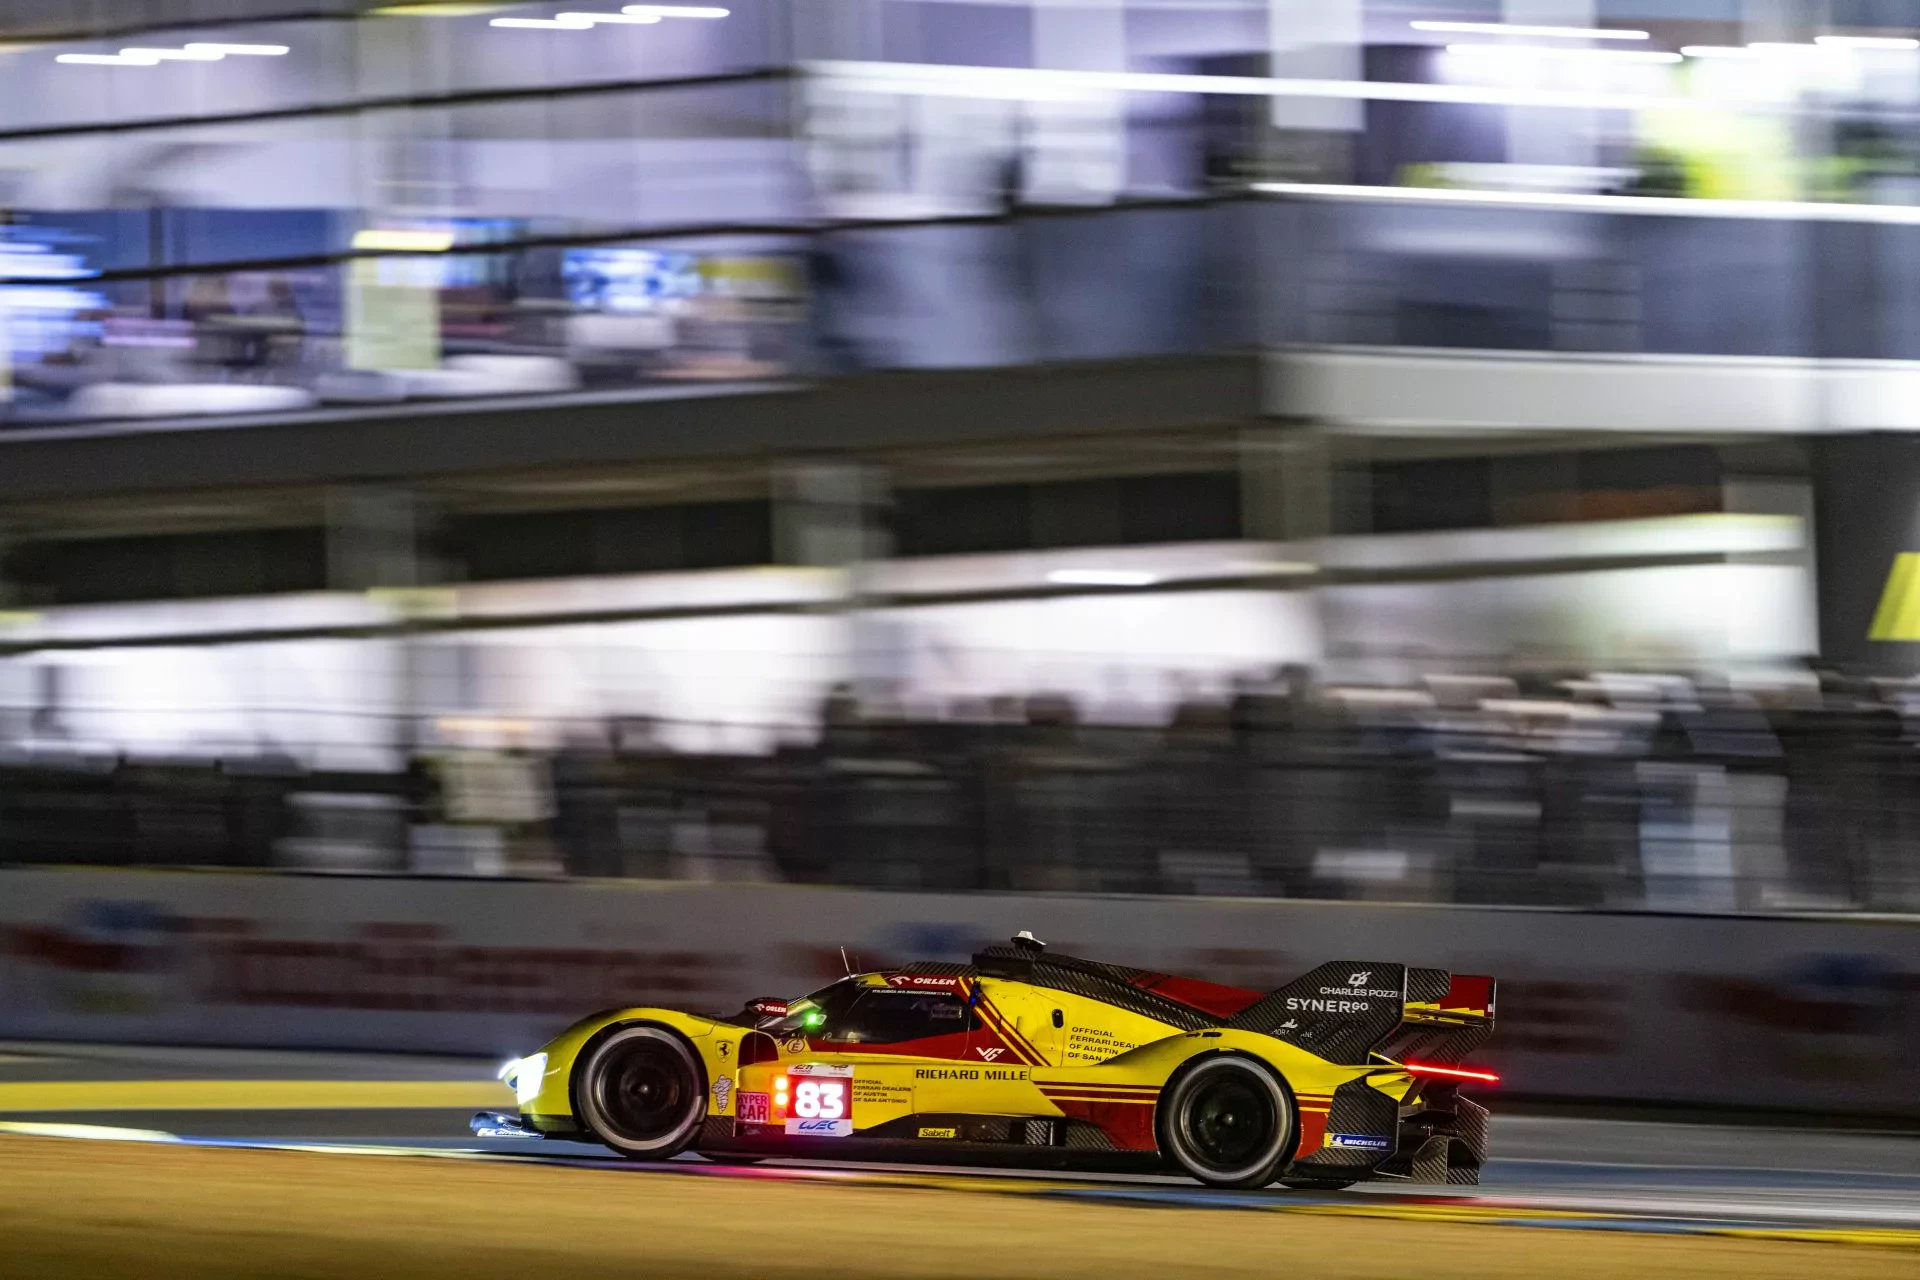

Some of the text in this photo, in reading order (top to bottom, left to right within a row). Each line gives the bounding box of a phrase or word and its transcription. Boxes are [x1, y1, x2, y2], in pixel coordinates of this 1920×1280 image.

[913, 977, 957, 986] ORLEN
[1319, 986, 1398, 998] CHARLES POZZI
[765, 1005, 787, 1013] ORLEN
[1071, 1026, 1115, 1038] OFFICIAL
[1070, 1034, 1111, 1045] FERRARI
[1083, 1045, 1119, 1055] AUSTIN
[1082, 1053, 1103, 1062] SAN
[915, 1069, 1028, 1080] RICHARD MILLE
[737, 1094, 768, 1105] HYPER
[795, 1082, 844, 1119] 83
[737, 1104, 767, 1120] CAR
[798, 1120, 839, 1130] WEC
[1343, 1139, 1388, 1147] MICHELIN
